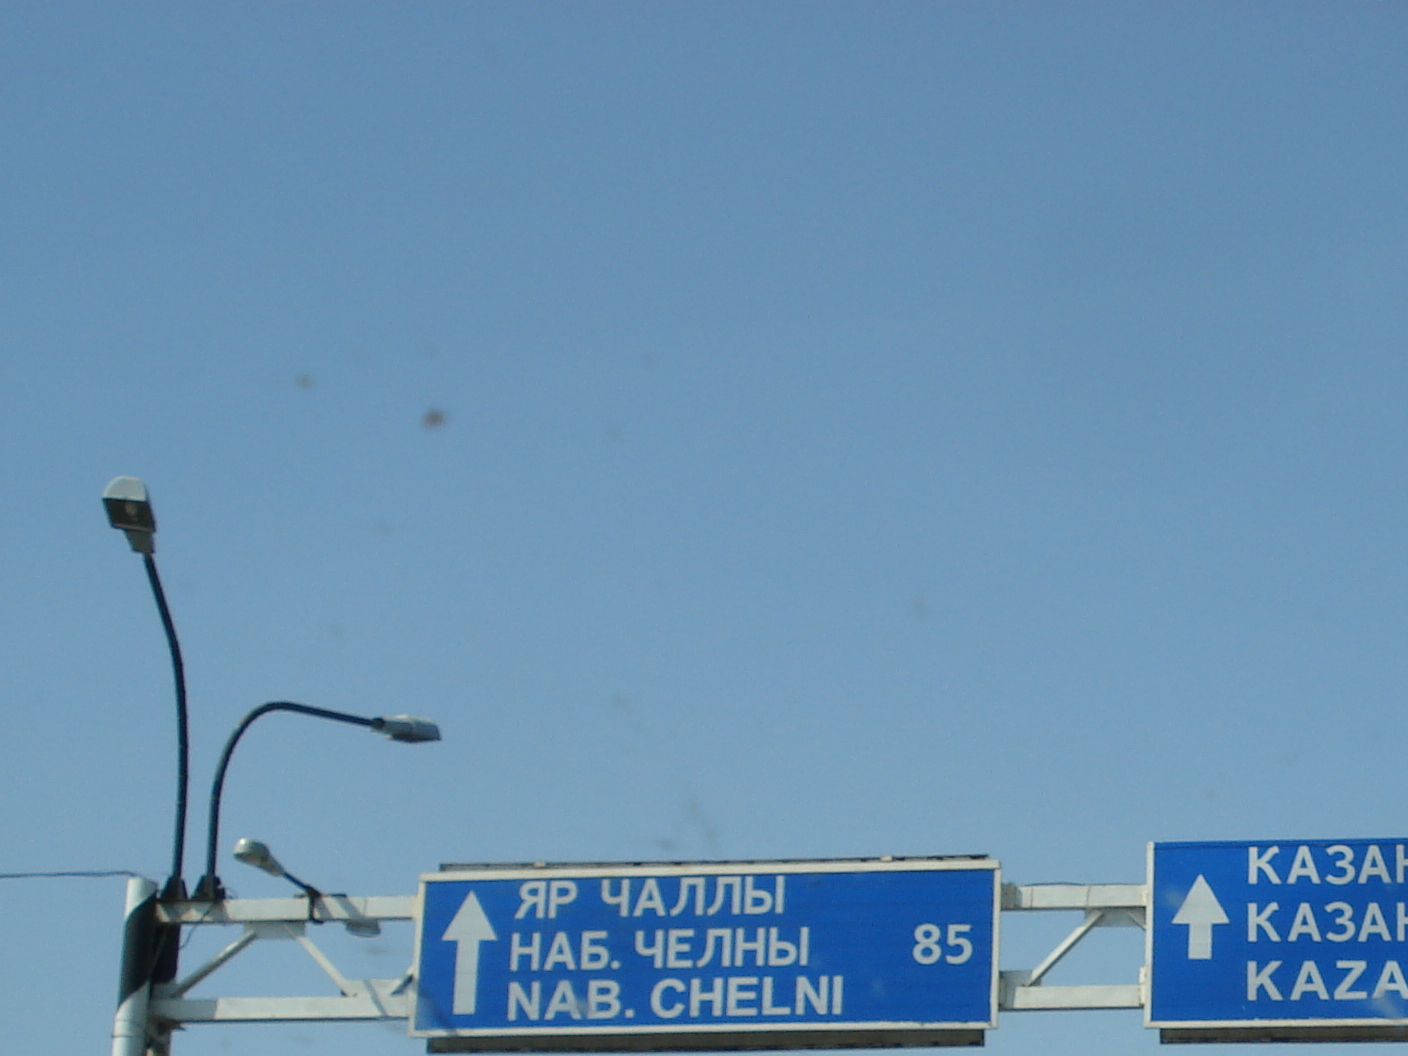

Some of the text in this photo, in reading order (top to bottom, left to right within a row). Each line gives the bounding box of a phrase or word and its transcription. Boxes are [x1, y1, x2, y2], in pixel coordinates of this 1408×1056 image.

[514, 875, 786, 919] ЯР ЧАЛЛЫ
[509, 926, 810, 971] НАБ. ЧЕЛНЫ
[912, 923, 974, 965] 85
[506, 975, 844, 1021] NAB. CHELNI
